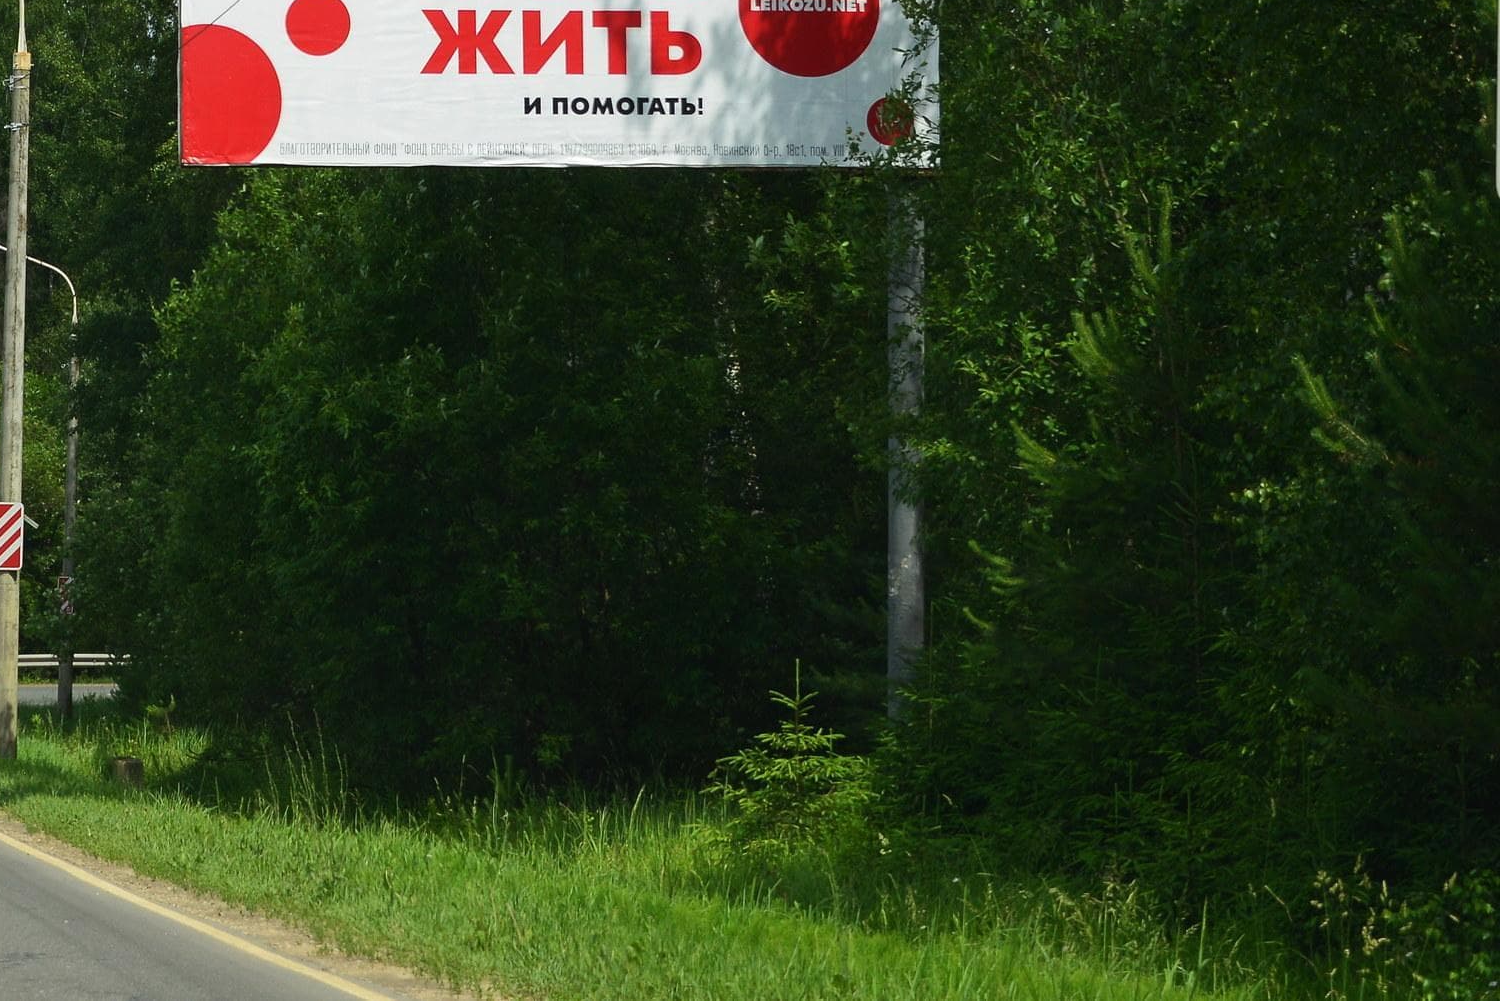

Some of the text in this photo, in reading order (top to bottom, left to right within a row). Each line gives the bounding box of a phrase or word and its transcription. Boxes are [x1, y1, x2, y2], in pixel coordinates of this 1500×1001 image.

[420, 9, 702, 75] ЖИТЬ
[524, 97, 703, 115] И ПОМОГАТЬ!
